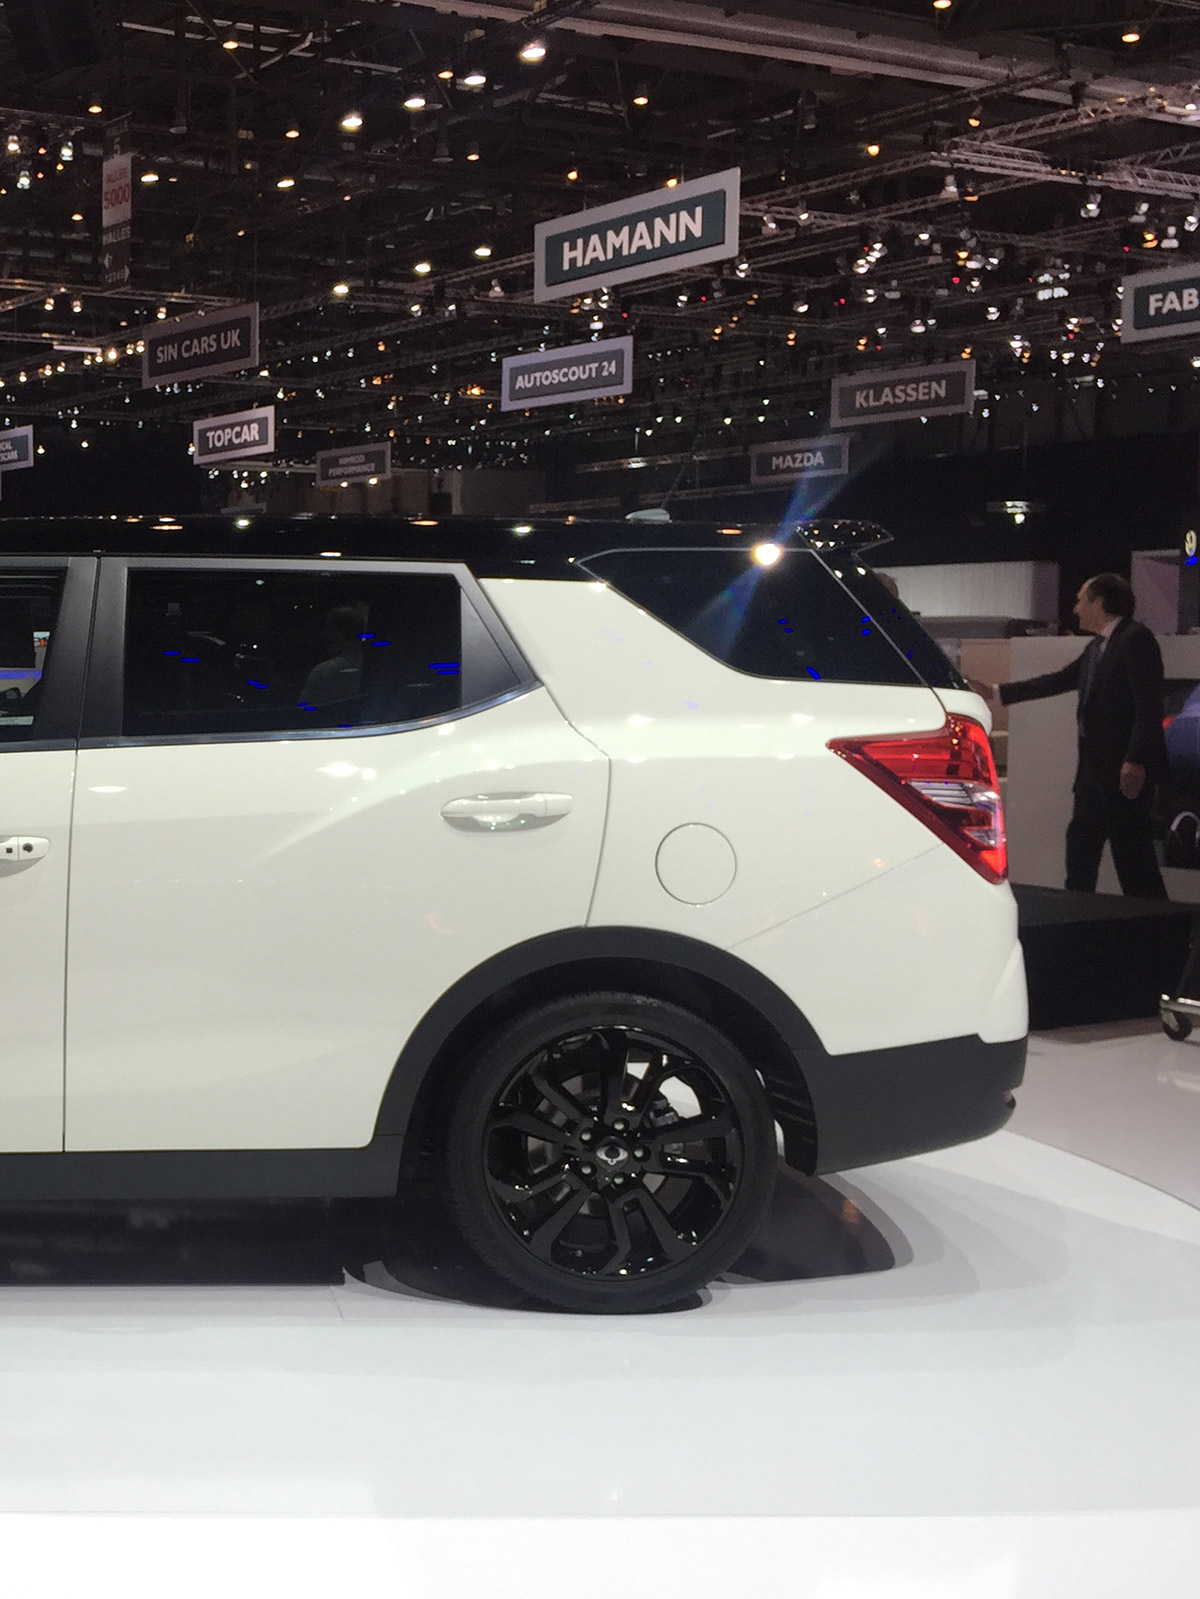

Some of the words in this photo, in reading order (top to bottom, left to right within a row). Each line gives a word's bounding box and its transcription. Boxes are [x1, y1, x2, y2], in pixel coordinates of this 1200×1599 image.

[103, 183, 131, 210] 5000
[562, 206, 704, 272] HAMANN
[1148, 287, 1200, 317] FAB
[155, 344, 179, 365] SIN
[181, 335, 218, 358] CARS
[219, 328, 242, 350] UK
[514, 363, 599, 391] AUTOSCOUT
[600, 359, 617, 378] 24
[854, 379, 948, 409] KLASSEN
[205, 421, 260, 445] TOPCAR
[771, 451, 825, 470] MAZDA
